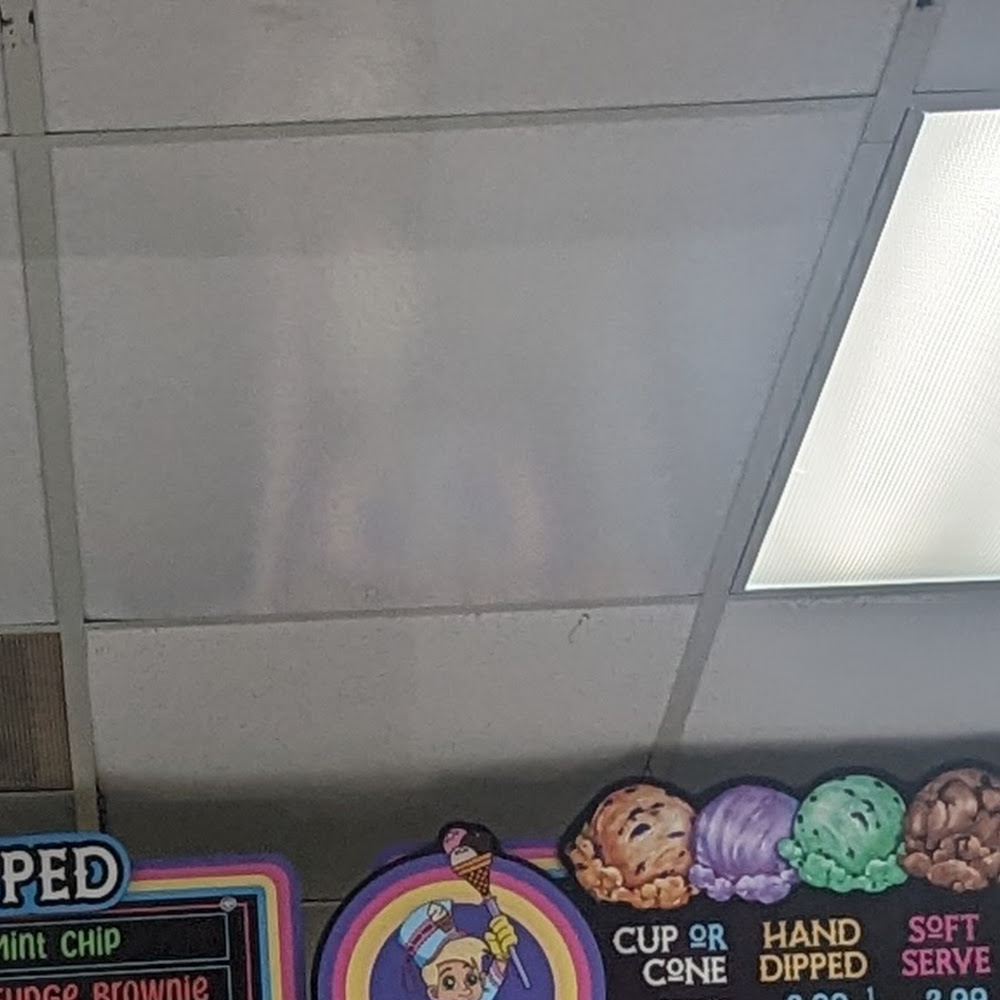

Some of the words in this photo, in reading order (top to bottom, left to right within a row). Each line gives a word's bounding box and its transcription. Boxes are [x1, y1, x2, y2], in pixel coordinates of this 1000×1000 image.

[60, 926, 121, 958] CHip
[612, 925, 678, 954] CUP
[689, 923, 728, 950] OR
[762, 917, 862, 950] HAND
[909, 913, 980, 943] SOFT
[642, 957, 728, 987] CONE
[759, 951, 868, 983] DIPPED
[901, 946, 992, 977] SERVE
